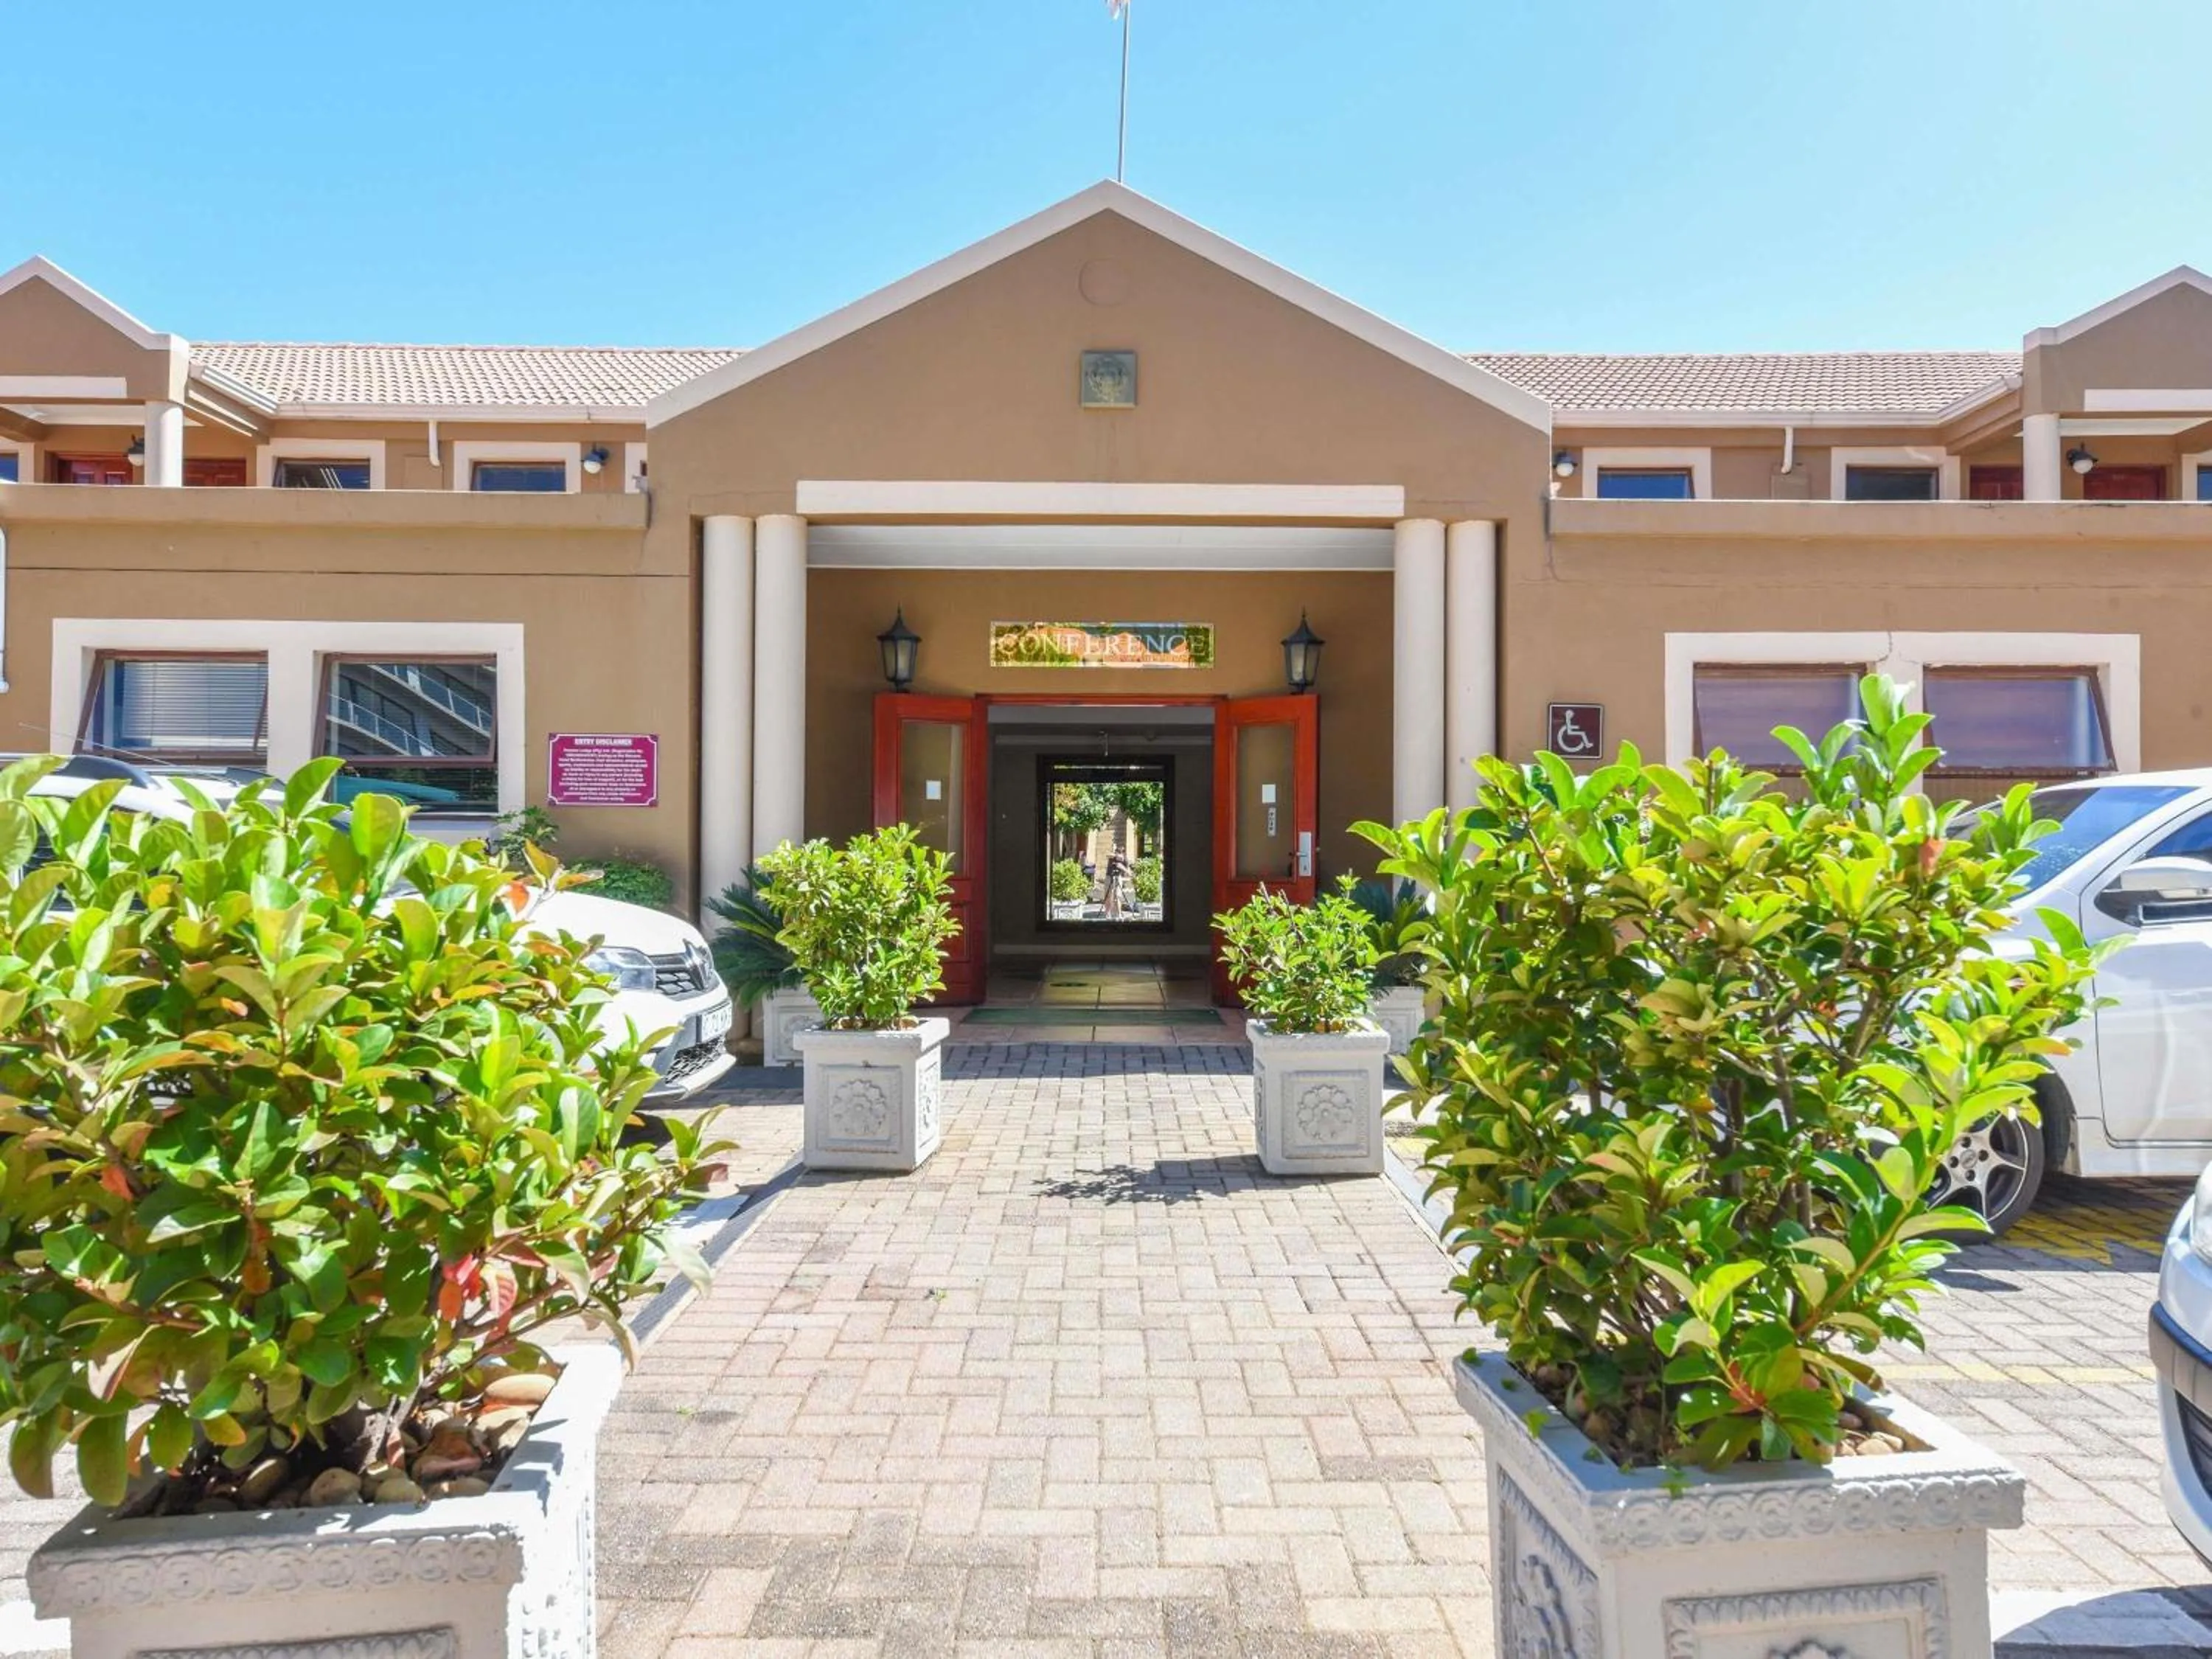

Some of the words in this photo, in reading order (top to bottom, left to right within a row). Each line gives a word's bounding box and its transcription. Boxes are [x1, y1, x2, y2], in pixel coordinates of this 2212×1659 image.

[997, 633, 1206, 655] CONFERENCE
[574, 737, 594, 745] ENTRY
[595, 738, 632, 746] DISCLAIMER
